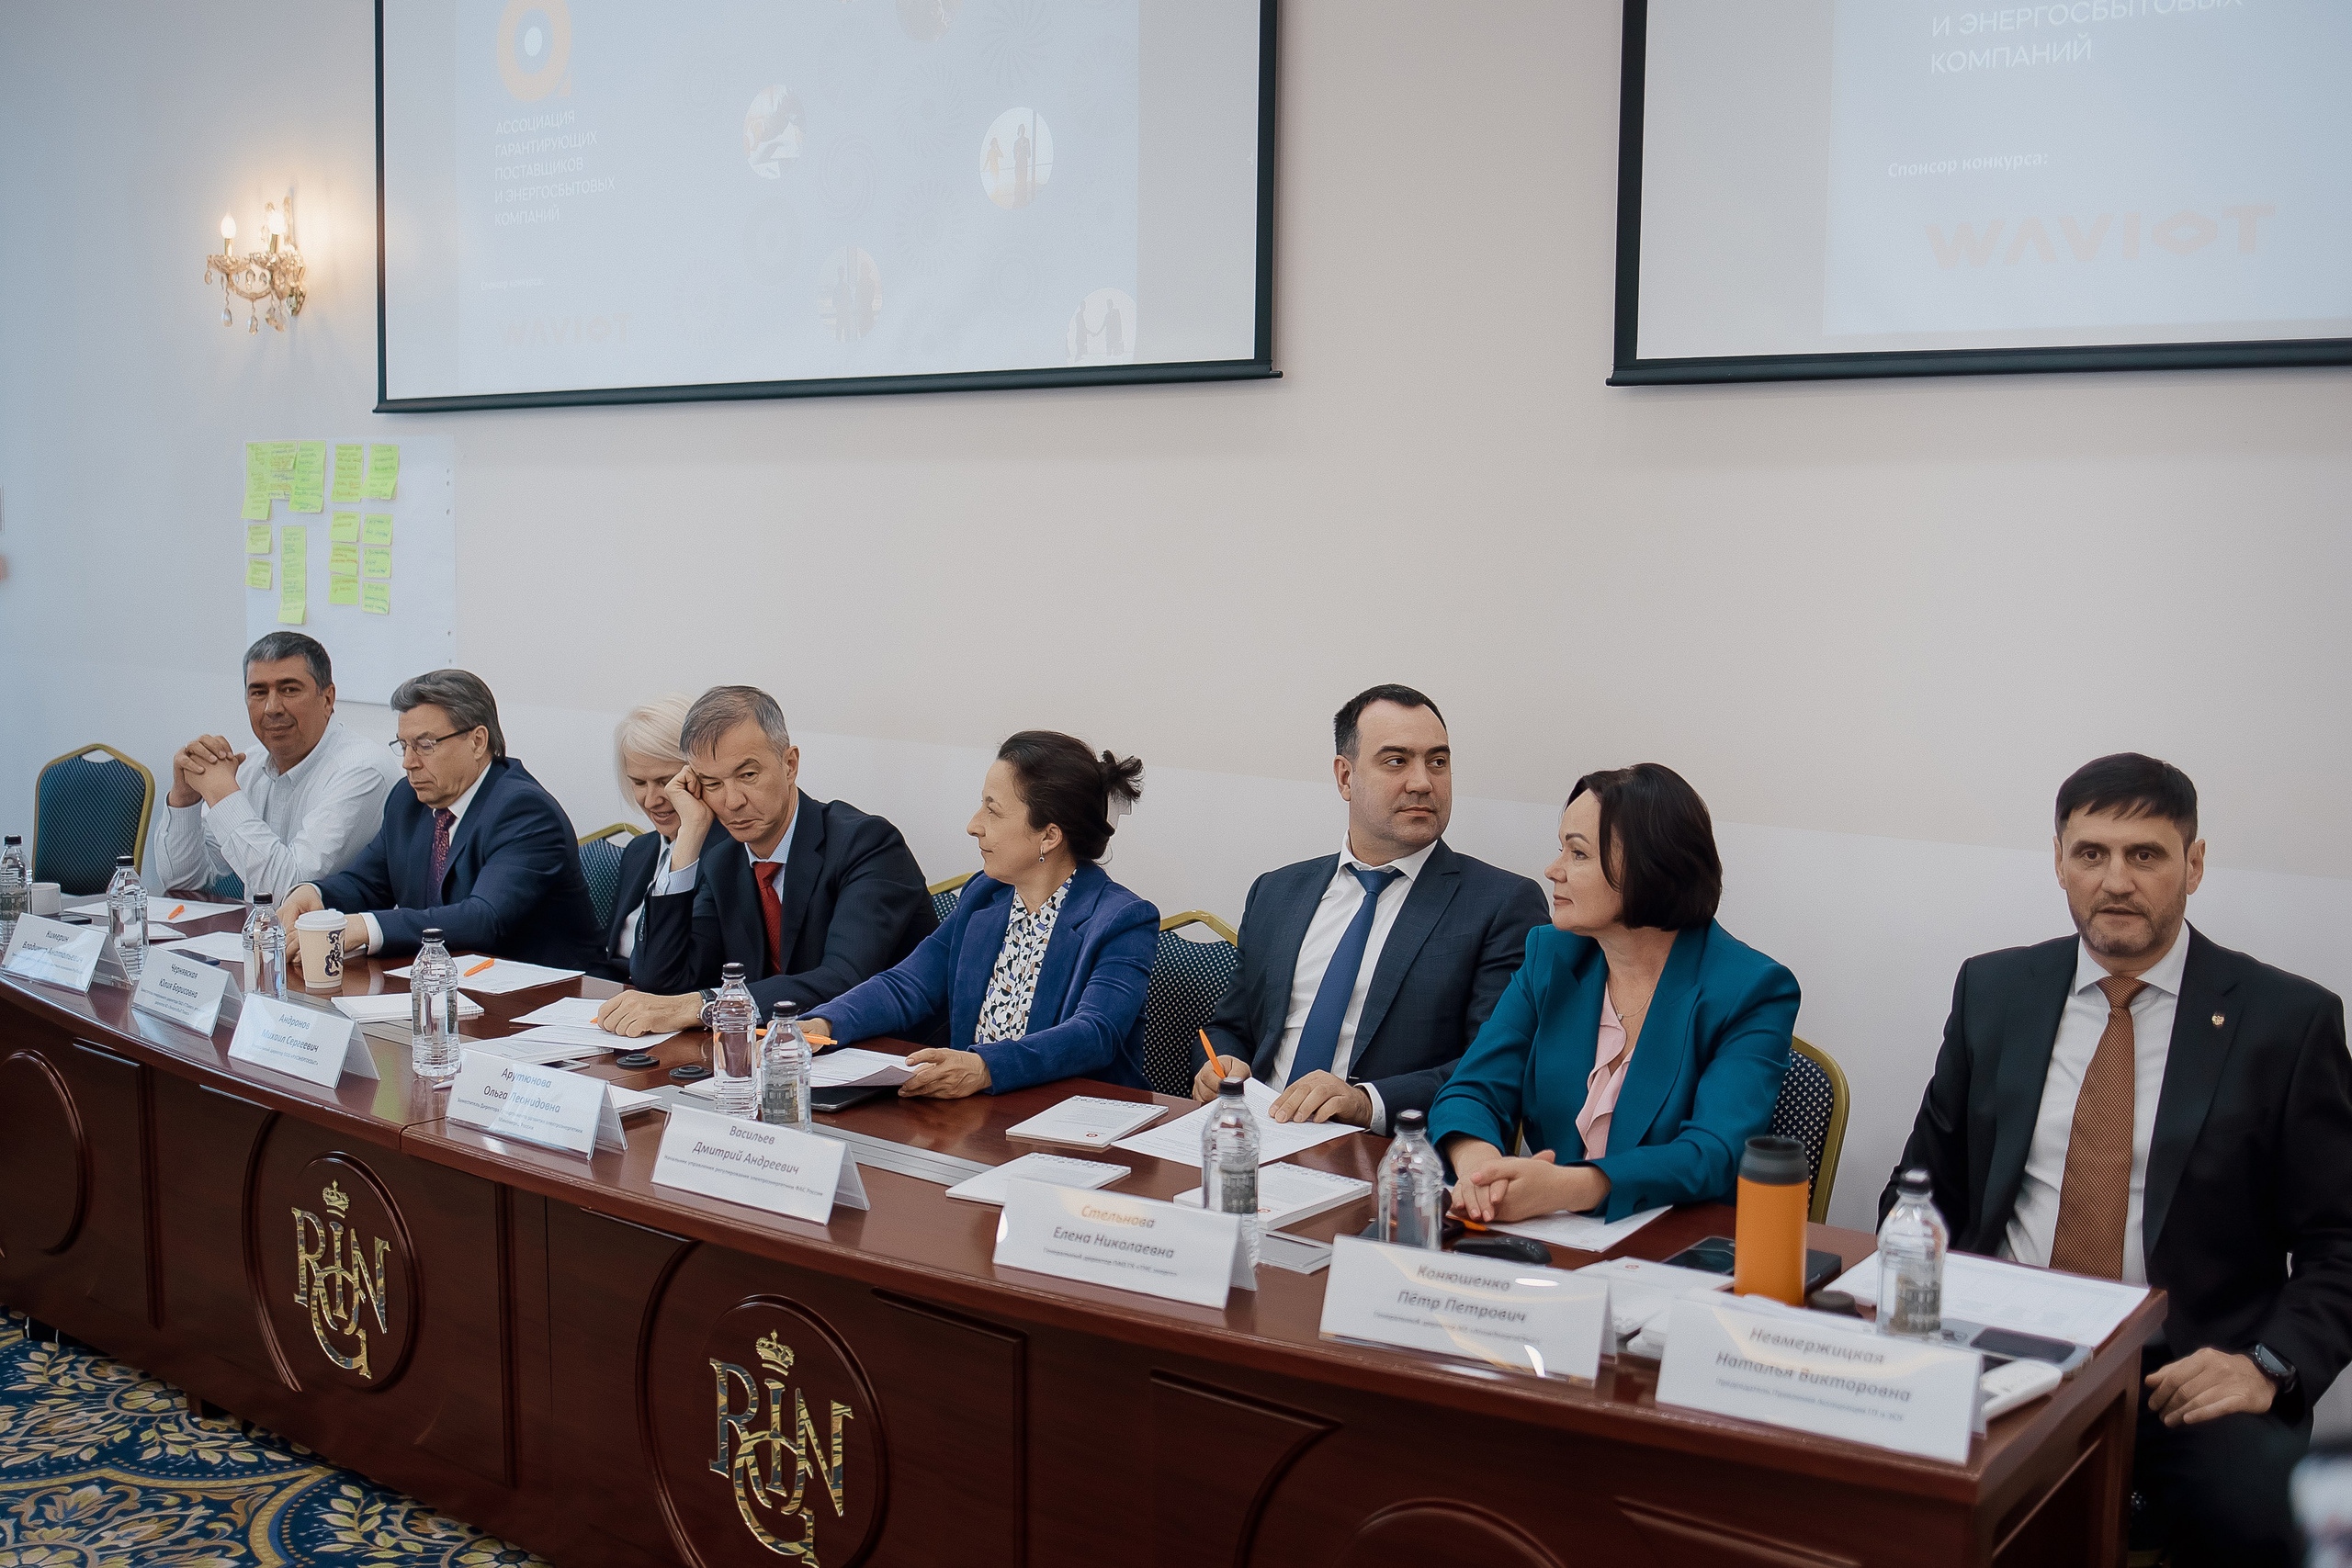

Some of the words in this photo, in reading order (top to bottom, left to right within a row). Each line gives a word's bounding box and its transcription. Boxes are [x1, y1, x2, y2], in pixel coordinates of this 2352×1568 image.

[1931, 15, 1951, 37] И
[1958, 0, 2241, 35] ЭНЕРГОСБЫТОВ
[1930, 32, 2093, 73] КОМПАНИЙ
[494, 109, 576, 136] АССОЦИАЦИЯ
[494, 130, 598, 158] ГАРАНТИРУЮЩИХ
[494, 156, 584, 182] ПОСТАВЩИКОВ
[1887, 158, 1958, 177] Спонсор
[1962, 152, 2049, 172] конкурса:
[494, 190, 503, 204] И
[505, 175, 616, 204] ЭНЕРГОСБЫТОВЫХ
[494, 204, 560, 227] КОМПАНИЙ
[1925, 204, 2276, 270] WAVIOT
[159, 977, 173, 989] Юлия
[172, 982, 198, 999] Борисовна
[278, 1013, 311, 1030] Андронов
[261, 1028, 286, 1043] Михаил
[286, 1035, 320, 1054] Сергеевич
[501, 1067, 552, 1089] Арутюнова
[483, 1085, 509, 1100] Ольга
[509, 1091, 561, 1113] Леонидовна
[729, 1125, 775, 1145] Васильев
[692, 1141, 742, 1162] Дмитрий
[742, 1153, 800, 1176] Андреевич
[1080, 1203, 1156, 1229] Стельнова
[1052, 1225, 1091, 1245] Елена
[1093, 1234, 1176, 1259] Николаевна
[1417, 1264, 1511, 1292] Конюшенко
[1396, 1289, 1442, 1313] Пётр
[1443, 1297, 1526, 1325] Петрович
[1748, 1326, 1885, 1365] Невмержицкая
[1714, 1350, 1794, 1379] Наталья
[1797, 1367, 1912, 1404] Викторовна
